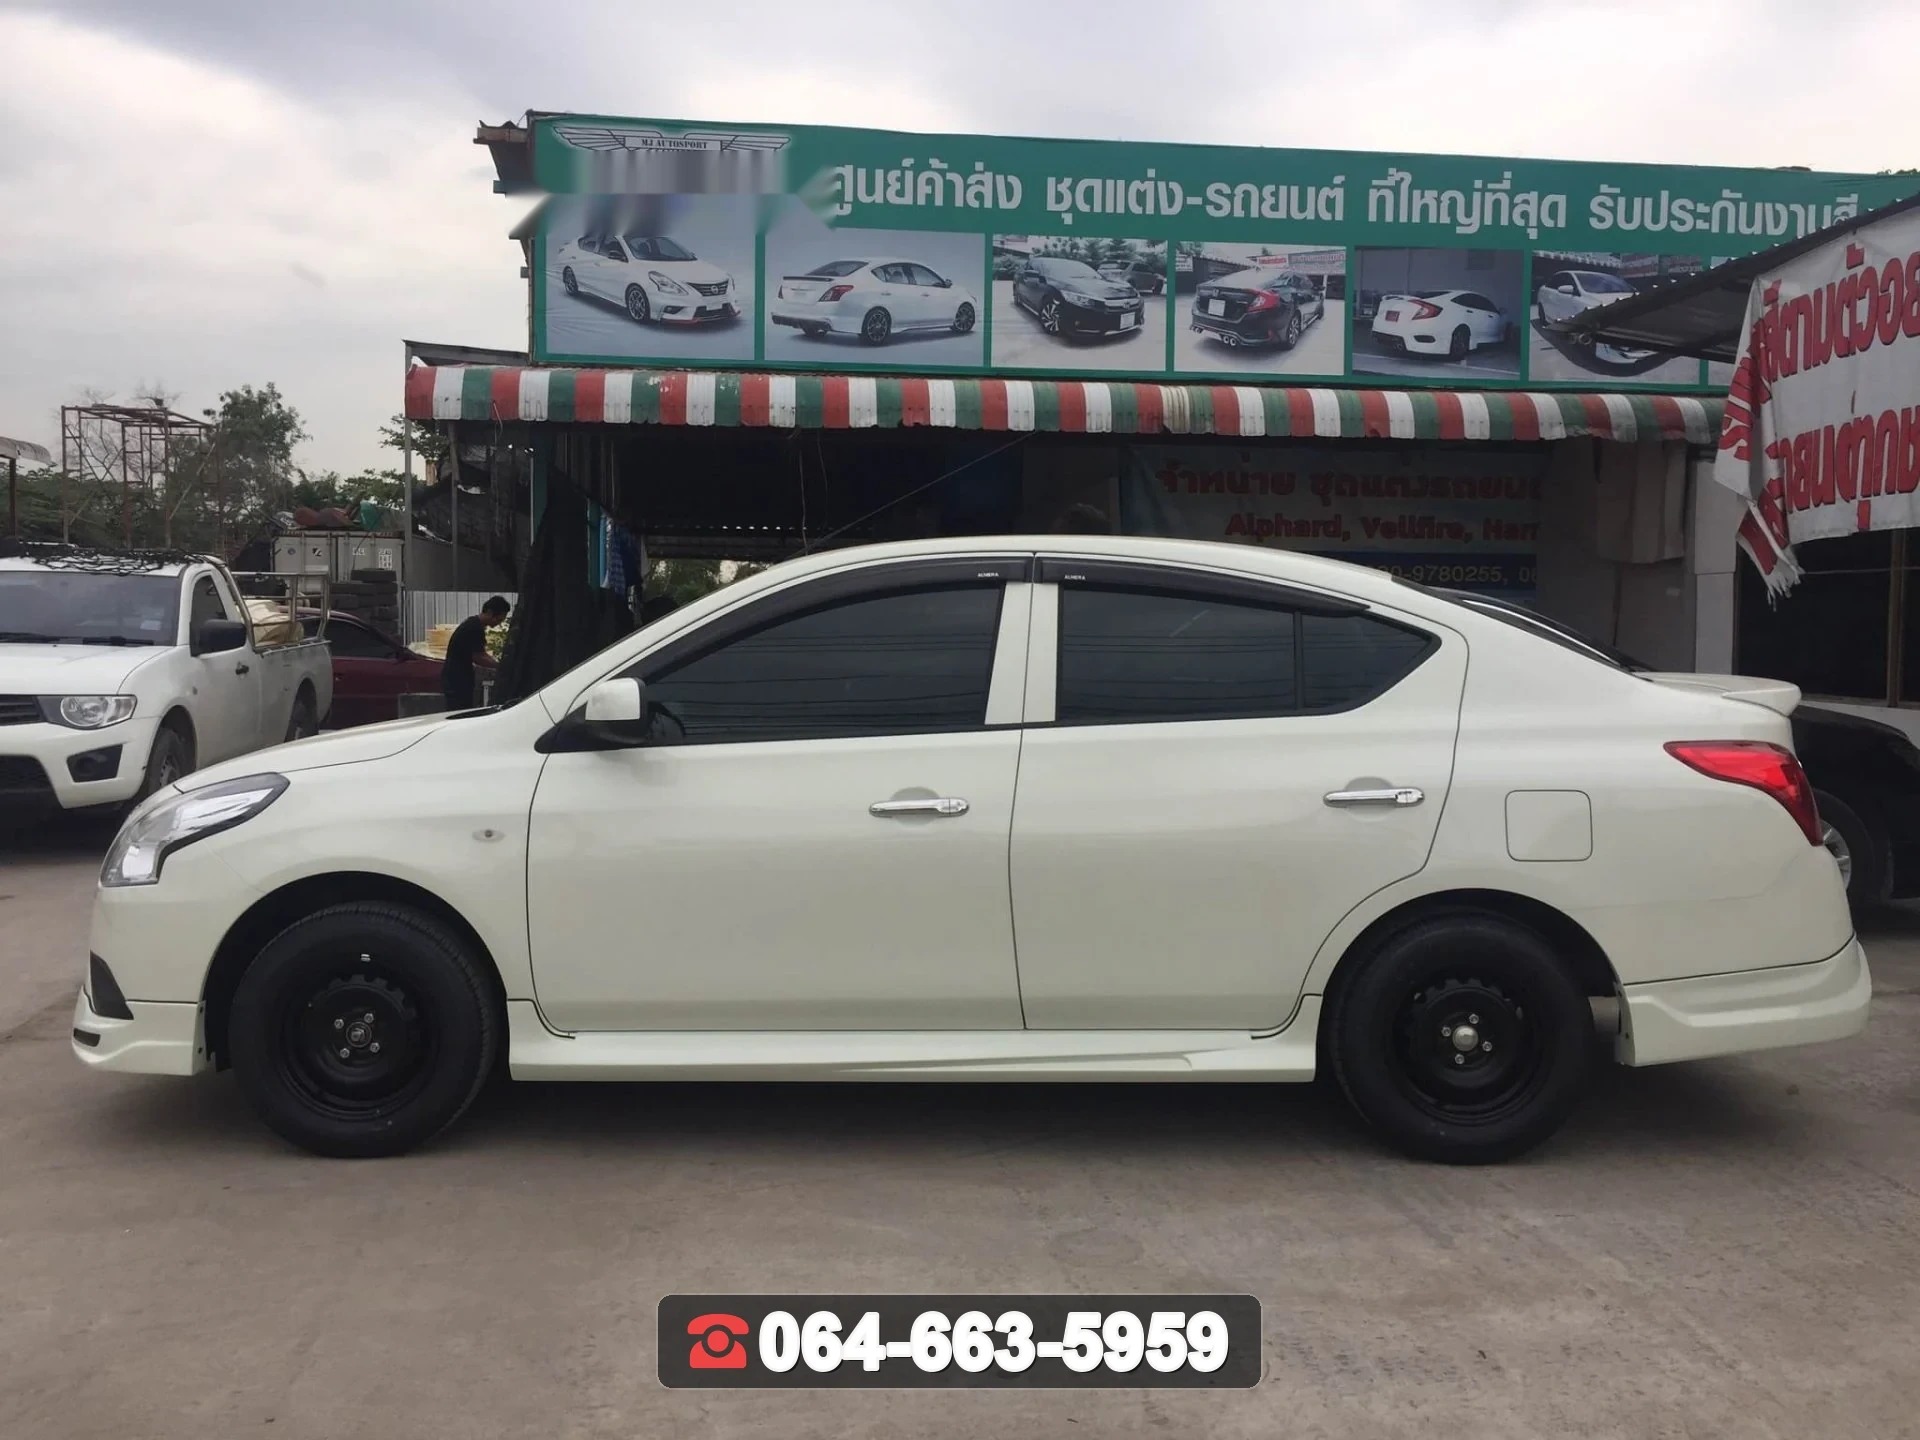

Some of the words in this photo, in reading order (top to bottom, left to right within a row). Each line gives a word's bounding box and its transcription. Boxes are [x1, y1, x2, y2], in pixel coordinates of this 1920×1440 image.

[641, 138, 654, 147] MJ
[657, 139, 708, 149] AUTOSPORT
[1046, 168, 1346, 225] ชุดแต่ง-รถยนต์
[1368, 167, 1567, 239] ที่ใหญ่ที่สุด
[1155, 452, 1296, 496] จำหน่าย
[1225, 512, 1351, 543] Alphard,
[1360, 514, 1473, 544] Vellfire,
